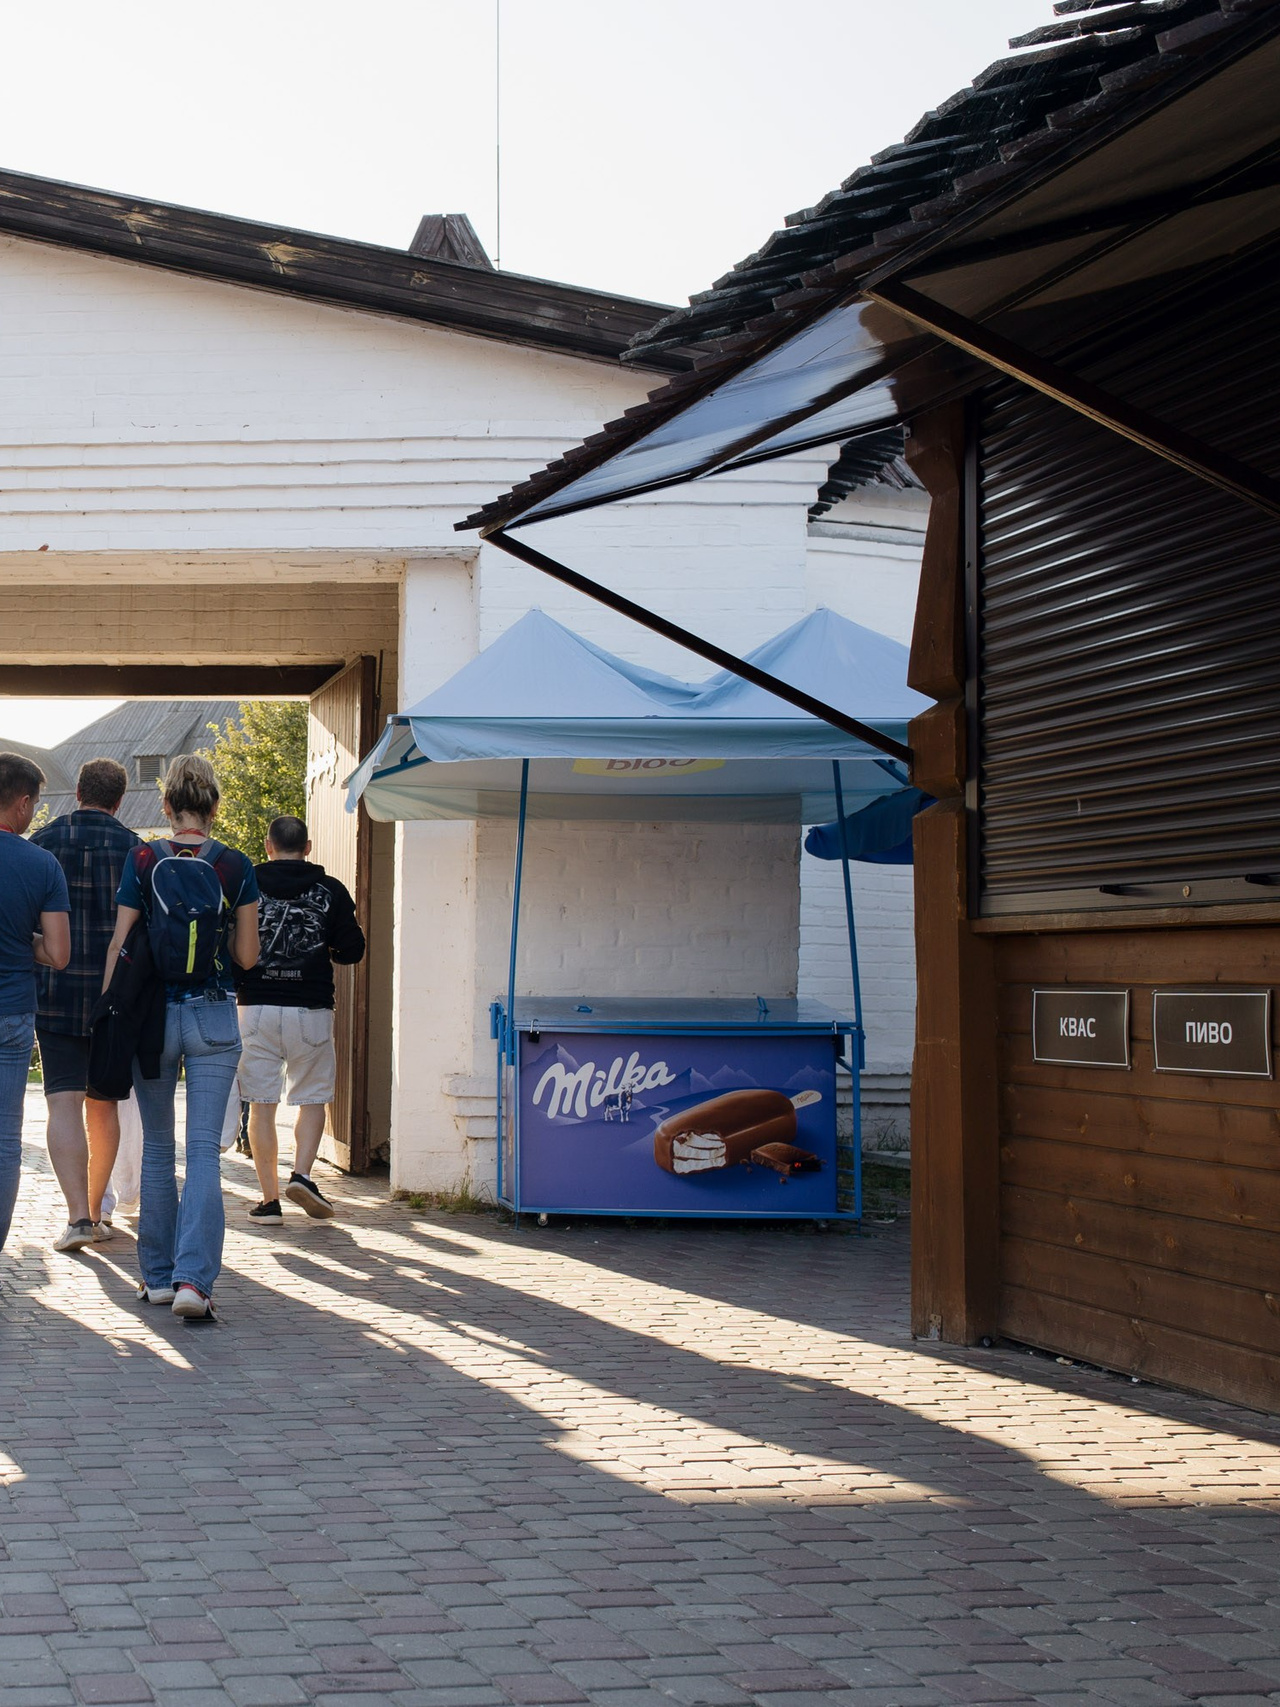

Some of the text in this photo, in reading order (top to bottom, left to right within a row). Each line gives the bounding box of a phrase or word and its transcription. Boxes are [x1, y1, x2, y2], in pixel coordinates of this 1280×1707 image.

[1059, 1016, 1097, 1038] КВАС
[1185, 1021, 1233, 1045] ПИВО
[532, 1051, 677, 1119] Milka
